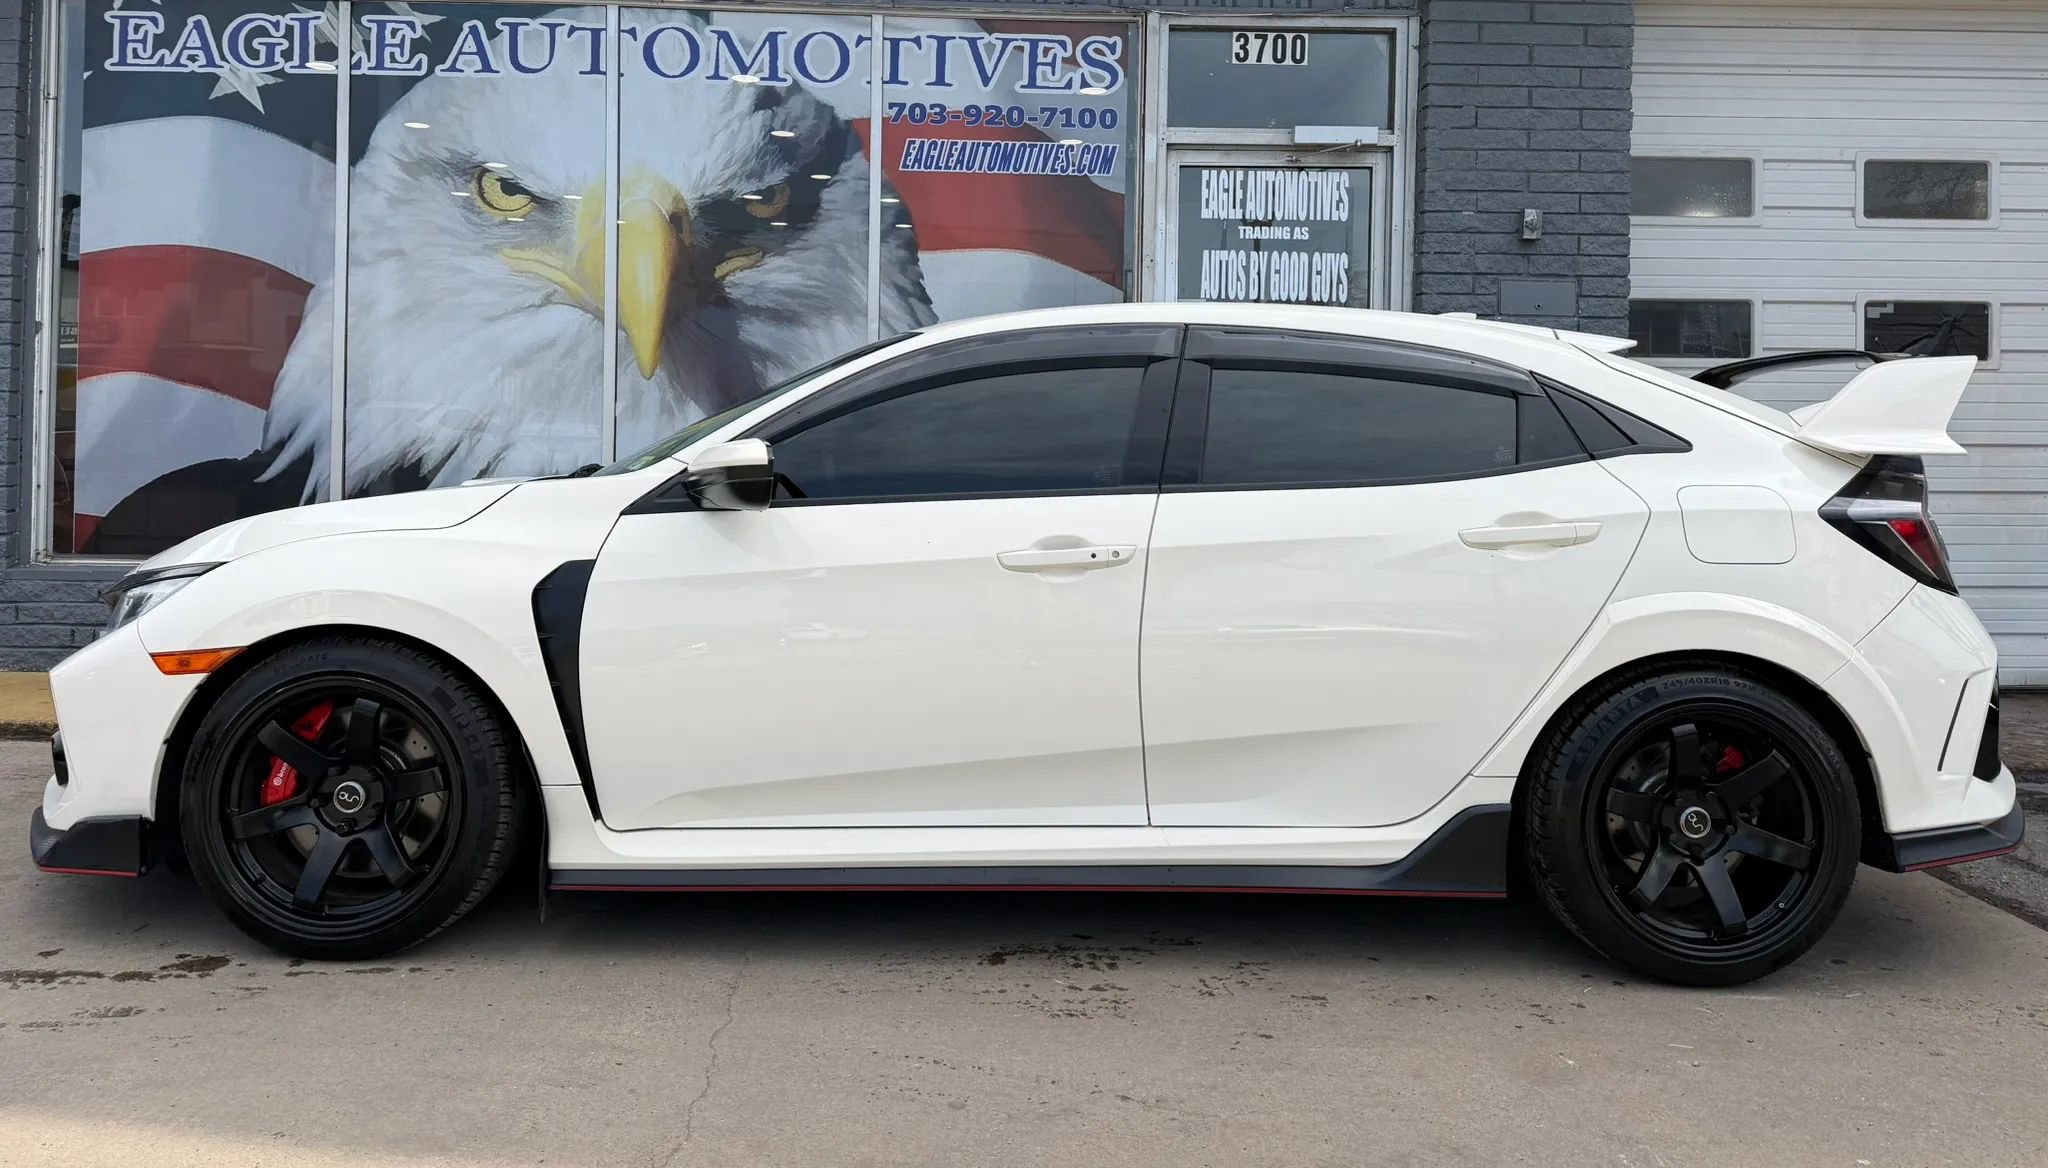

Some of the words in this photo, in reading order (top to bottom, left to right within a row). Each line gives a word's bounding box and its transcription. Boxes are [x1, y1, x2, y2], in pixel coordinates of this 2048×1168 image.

[106, 13, 427, 75] EAGLE
[437, 19, 1124, 94] AUTOMOTIVES
[1234, 32, 1306, 64] 3700
[888, 102, 1119, 130] 703-920-7100
[900, 138, 1119, 177] EAGLEAUTOMOTIVES.COM
[1201, 169, 1243, 219] EAGLE
[1246, 170, 1349, 222] AUTOMOTIVES
[1238, 225, 1291, 240] TRADING
[1293, 226, 1310, 240] AS
[1200, 250, 1246, 300] AUTOS
[1249, 251, 1268, 300] BY
[1270, 251, 1309, 301] GOOD
[1311, 251, 1349, 303] GUYS
